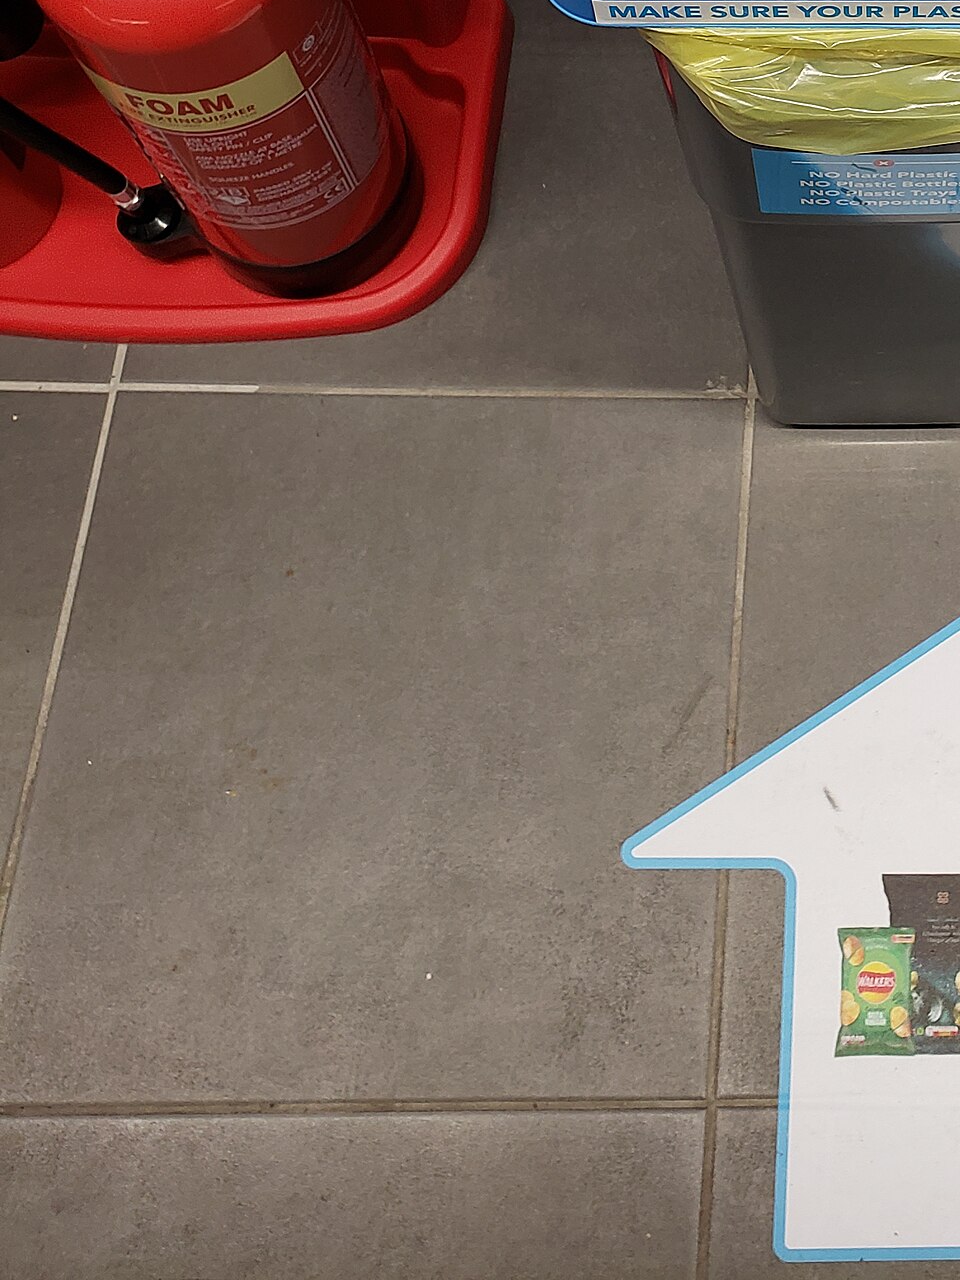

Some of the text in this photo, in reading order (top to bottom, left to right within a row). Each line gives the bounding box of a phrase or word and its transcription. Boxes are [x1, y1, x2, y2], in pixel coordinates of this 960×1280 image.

[608, 5, 703, 18] MAKE
[710, 5, 789, 18] SURE
[796, 5, 884, 18] YOUR
[125, 93, 234, 115] FOAM
[150, 105, 255, 124] EXTINGUISHER
[809, 170, 958, 179] NO Hard Plastic
[799, 180, 831, 188] NO
[836, 180, 897, 188] Plastic
[809, 189, 957, 198] NO Plastic Trays
[800, 198, 831, 206] NO
[859, 974, 895, 988] WALKERS
